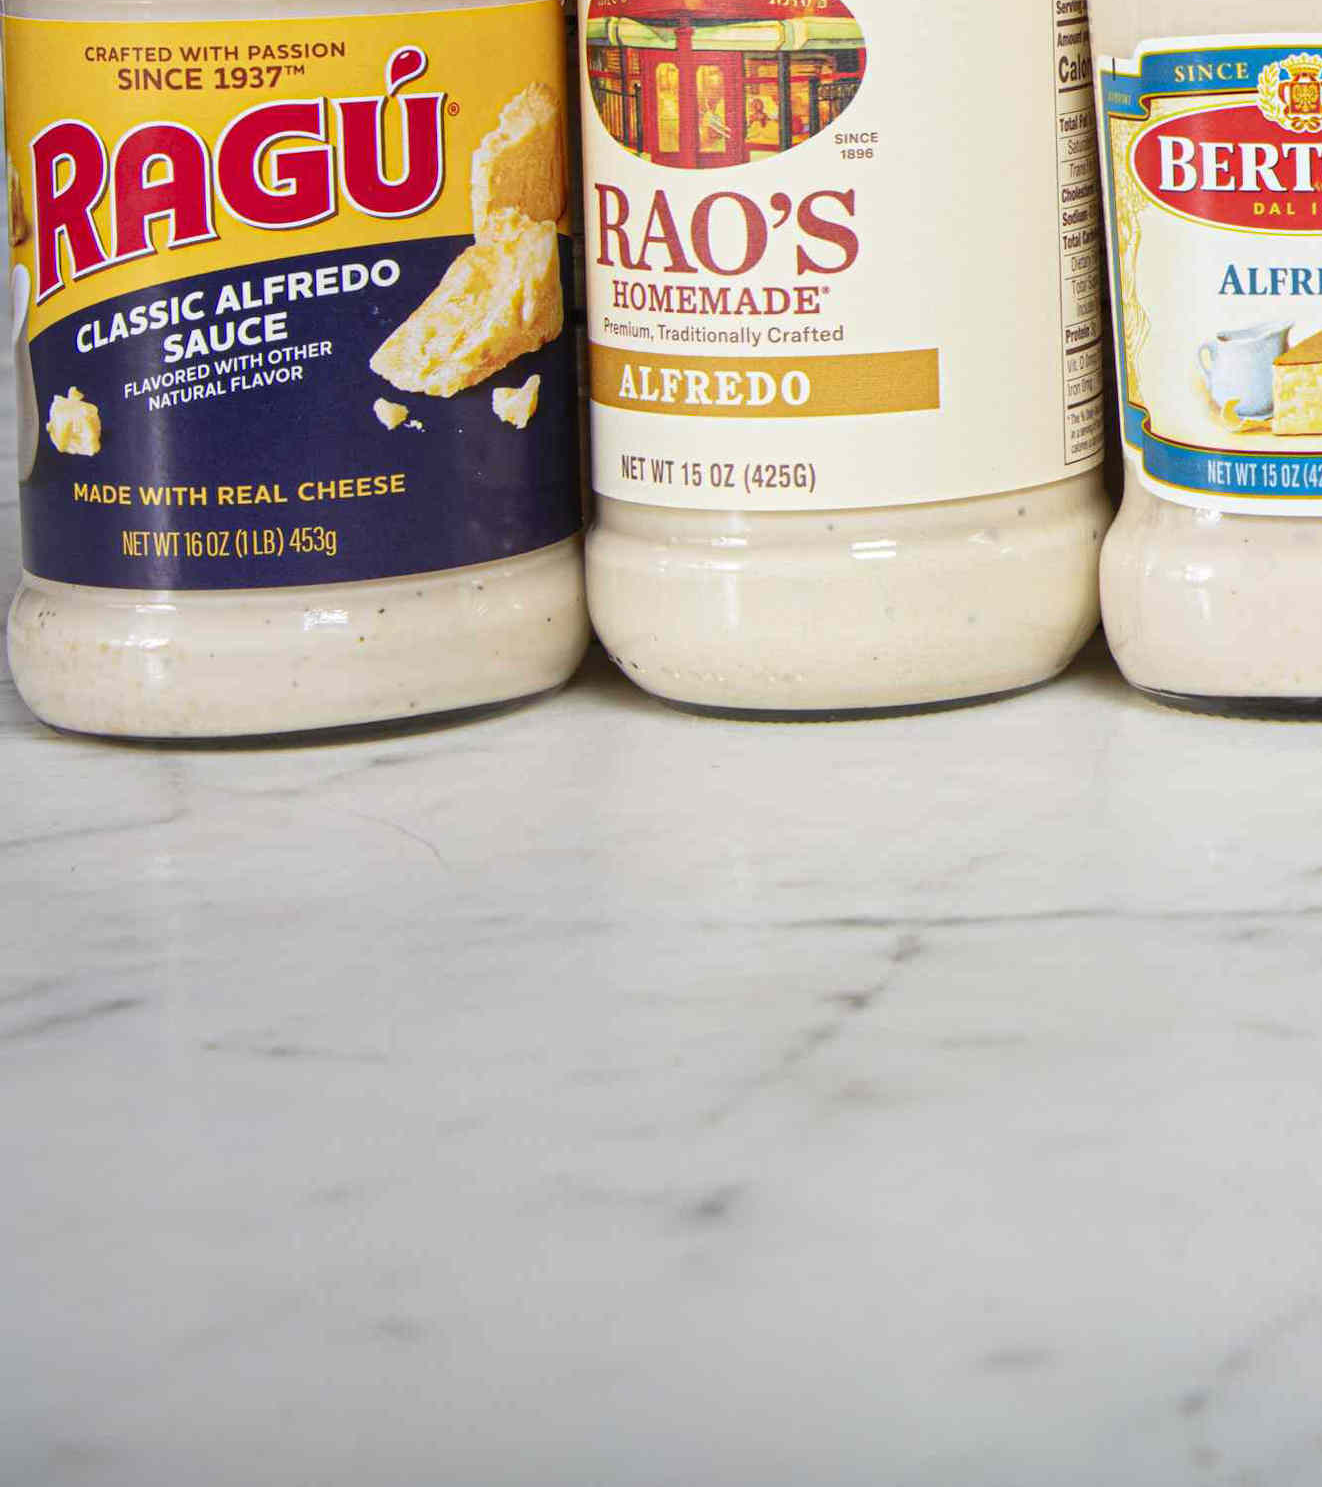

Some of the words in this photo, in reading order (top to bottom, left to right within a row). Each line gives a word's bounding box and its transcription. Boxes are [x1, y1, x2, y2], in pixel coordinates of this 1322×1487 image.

[85, 44, 171, 62] CRAFTED
[180, 44, 239, 61] WITH
[248, 41, 345, 59] PASSION
[118, 68, 202, 89] SINCE
[1175, 62, 1249, 82] SINCE
[834, 131, 879, 144] SINCE
[841, 148, 873, 160] 1896
[1254, 202, 1294, 216] DAL
[595, 183, 859, 276] RAO'S
[77, 291, 203, 352] CLASSIC
[216, 258, 400, 314] ALFREDO
[612, 280, 821, 315] HOMEMADE
[163, 312, 288, 363] SAUCE
[604, 317, 654, 343] Premium,
[658, 325, 761, 345] Traditionally
[768, 324, 844, 343] Crafted
[124, 363, 208, 399] FLAVORED
[213, 355, 264, 376] WITH
[267, 342, 332, 364] OTHER
[619, 365, 810, 407] ALFREDO
[148, 383, 226, 411] NATURAL
[231, 365, 303, 393] FLAVOR
[74, 481, 132, 505] MADE
[140, 486, 207, 505] WITH
[218, 482, 287, 505] REAL
[297, 474, 405, 502] CHEESE
